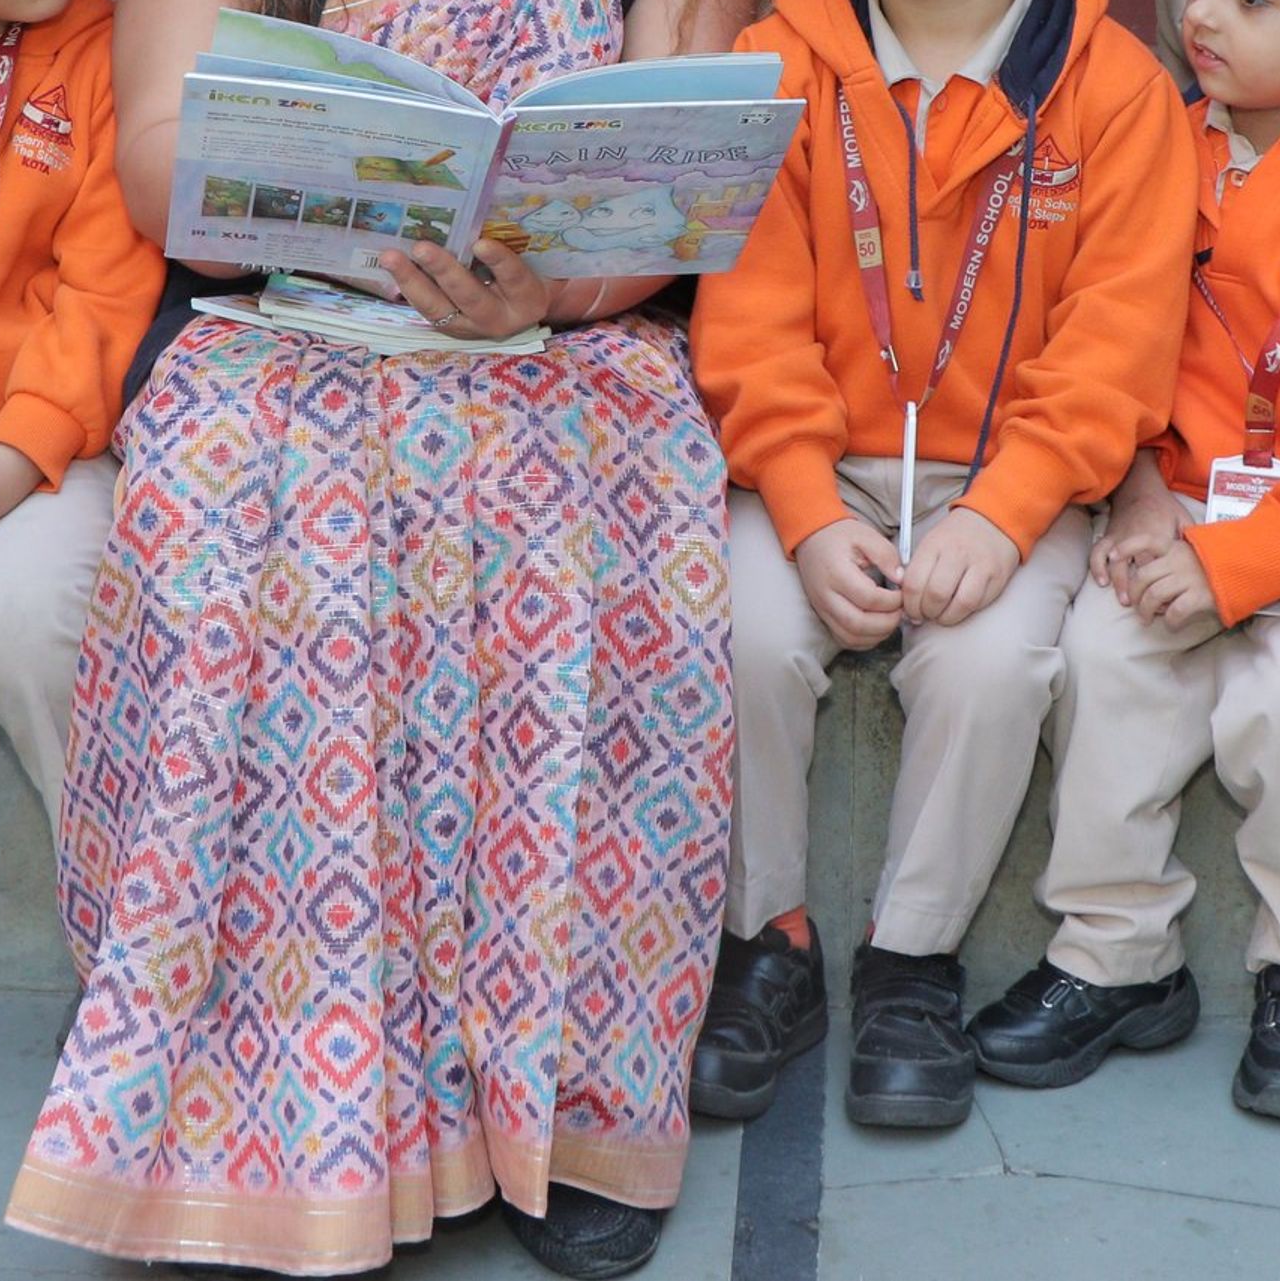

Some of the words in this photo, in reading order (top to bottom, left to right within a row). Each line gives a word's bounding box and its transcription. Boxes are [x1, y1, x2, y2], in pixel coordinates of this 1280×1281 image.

[21, 156, 50, 174] KOTA
[504, 146, 627, 171] RAIN
[649, 144, 748, 166] RIDE
[858, 241, 876, 257] 50
[950, 250, 985, 331] MODERN
[976, 170, 1014, 246] SCHOOL
